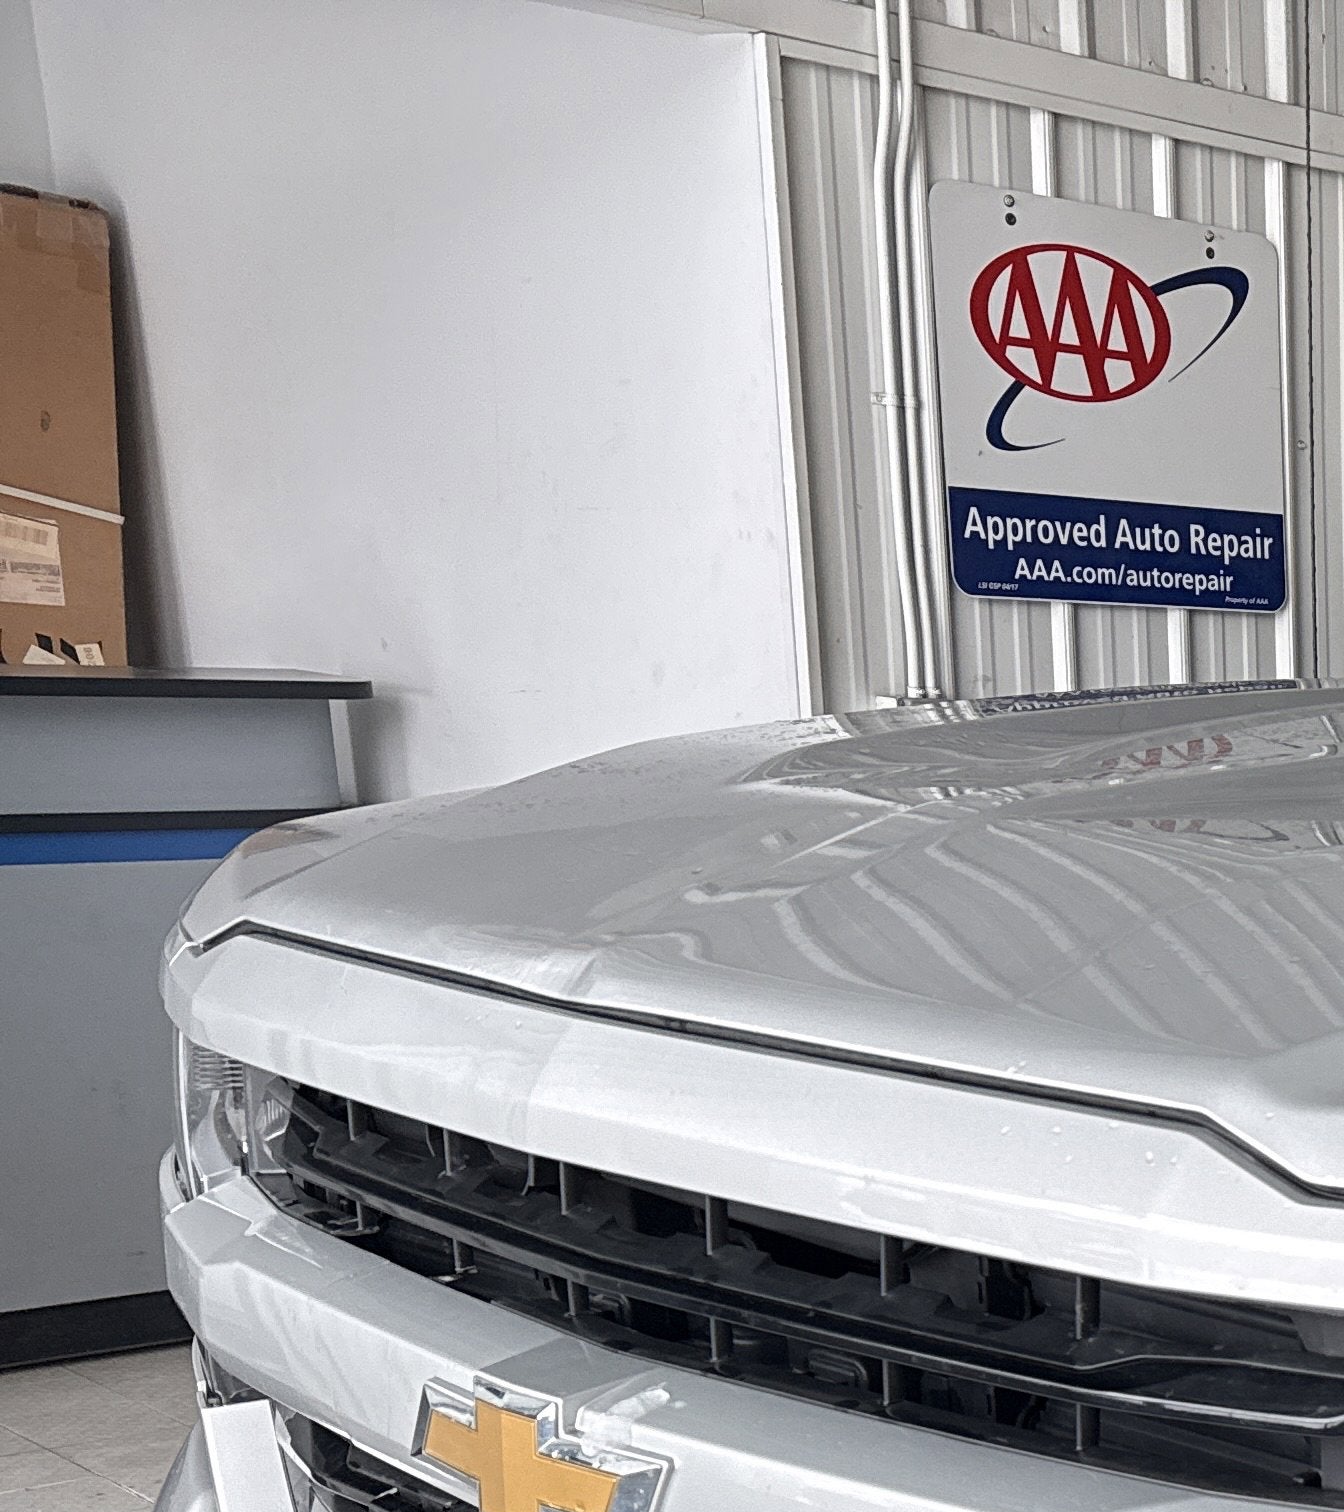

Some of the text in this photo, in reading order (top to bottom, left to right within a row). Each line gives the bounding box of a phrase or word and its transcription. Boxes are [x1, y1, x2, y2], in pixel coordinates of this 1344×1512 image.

[970, 243, 1171, 403] AAA
[963, 506, 1274, 565] Approved Auto Repair
[1014, 557, 1235, 595] AAA.com/autorepair
